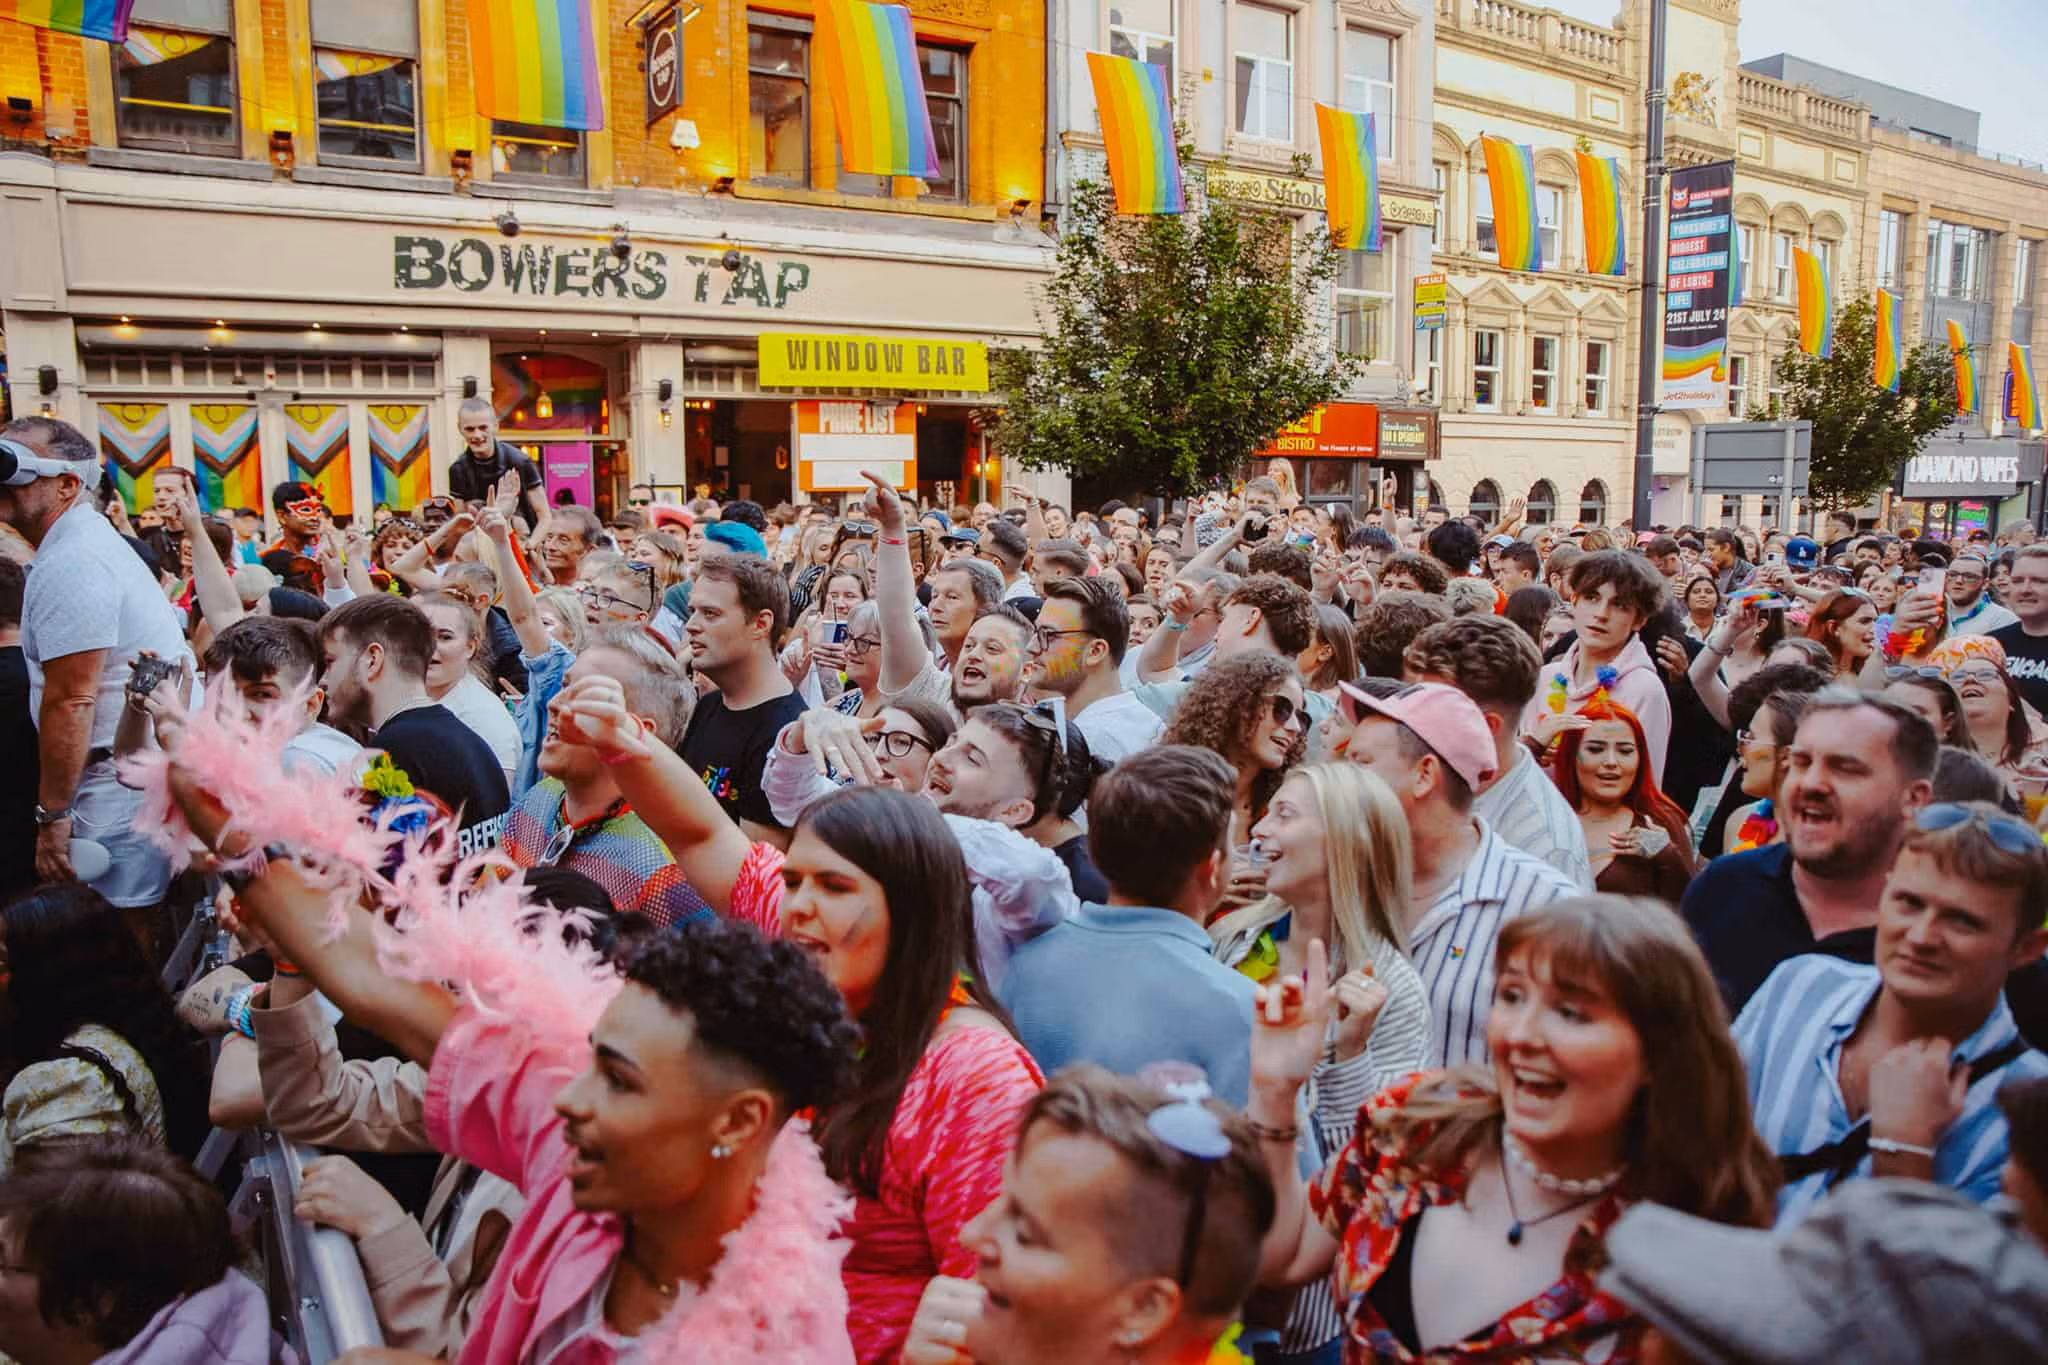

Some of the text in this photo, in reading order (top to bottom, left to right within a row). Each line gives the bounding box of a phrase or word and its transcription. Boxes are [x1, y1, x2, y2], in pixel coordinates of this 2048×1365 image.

[1671, 240, 1705, 255] BIGGEST
[393, 236, 810, 309] BOWERS TAP
[1670, 277, 1681, 289] OF
[1667, 307, 1726, 325] 21ST JULY 24
[786, 339, 966, 377] WINDOW BAR
[819, 402, 896, 433] PRICE LIST
[1277, 437, 1316, 451] BISTRO
[1907, 455, 2019, 483] DIAMOND VAPES
